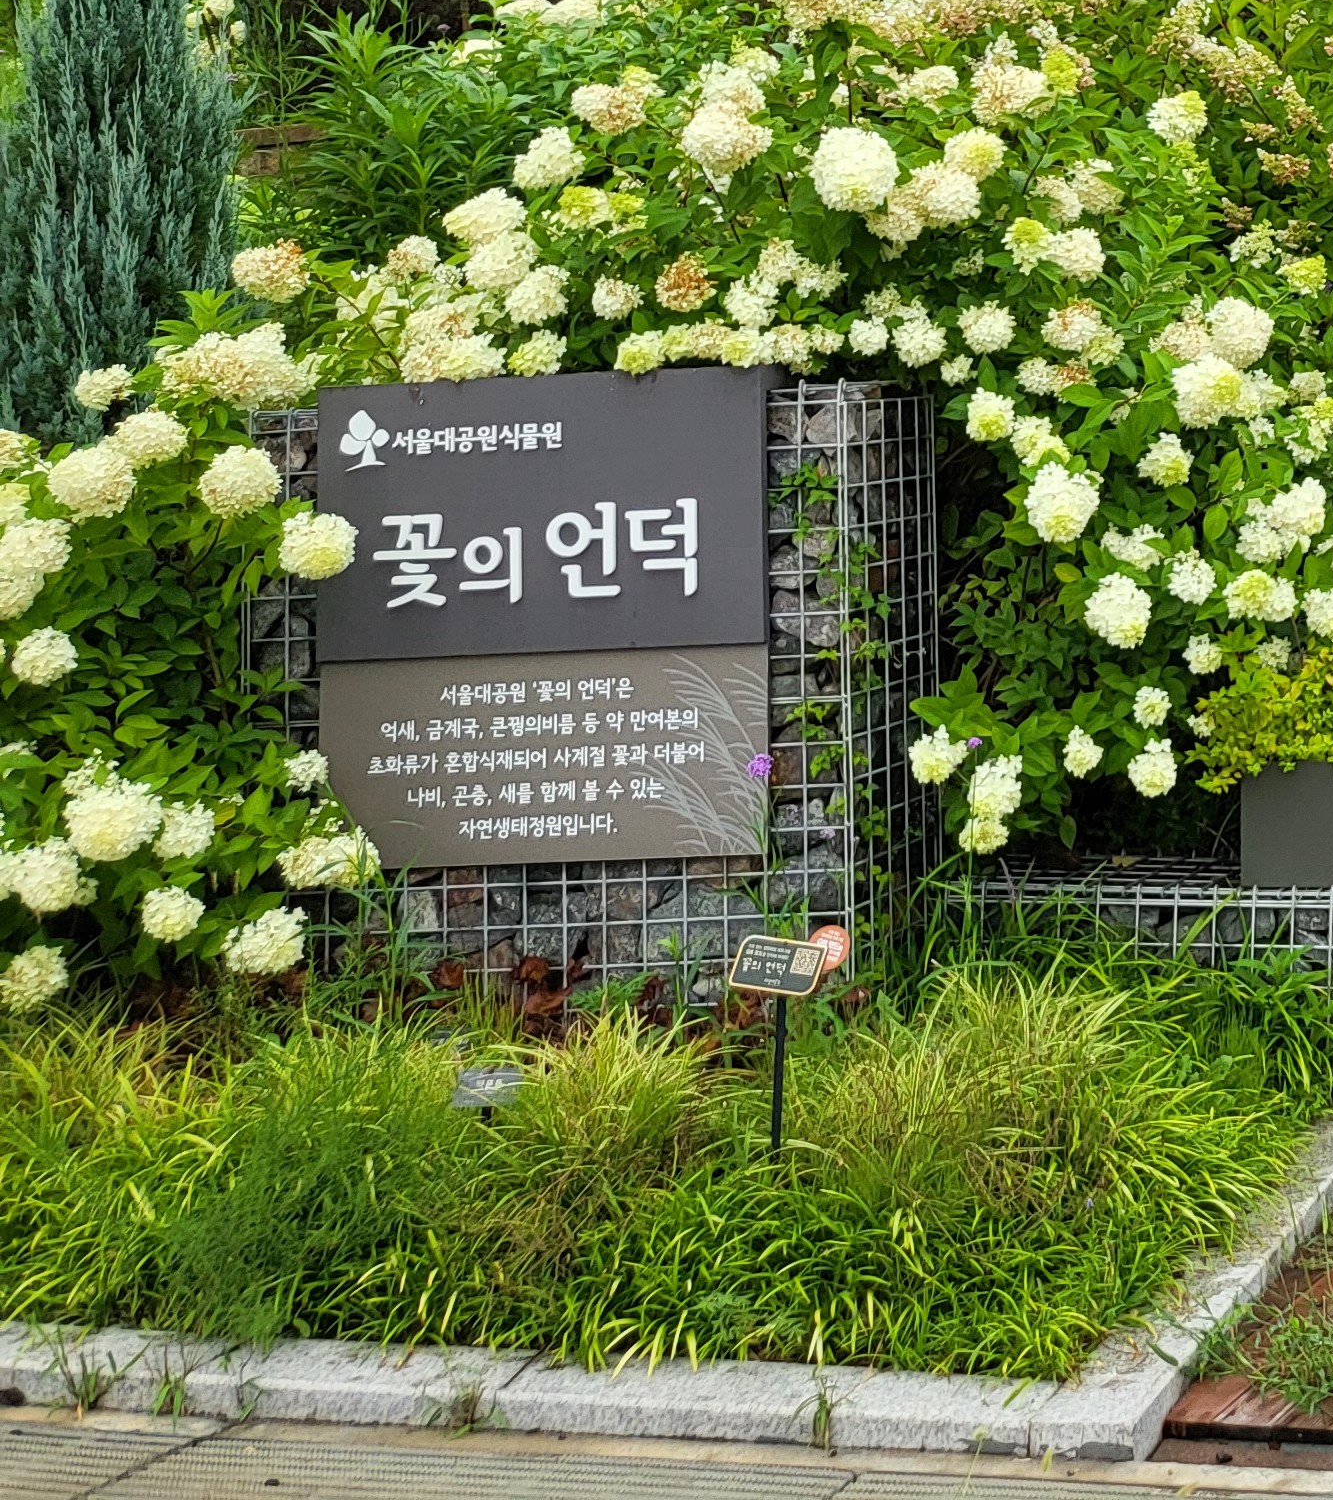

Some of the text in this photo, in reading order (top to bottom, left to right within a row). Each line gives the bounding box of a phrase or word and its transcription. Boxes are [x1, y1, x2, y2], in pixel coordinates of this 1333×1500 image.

[391, 421, 563, 455] 서울대공원식물원
[372, 497, 698, 608] 꽃의 언덕
[440, 681, 526, 706] 서울대공원
[380, 706, 699, 743] 억새, 금계국, 큰꿩의비름 등 약 만여본의
[367, 740, 705, 775] 초화류가 혼합식재되어 사계절 꽃과 더불어
[407, 776, 665, 808] 나비, 곤충, 새를 함께 볼 수 있는
[458, 812, 618, 840] 자연생태정원입니다.
[765, 960, 787, 977] 언덕
